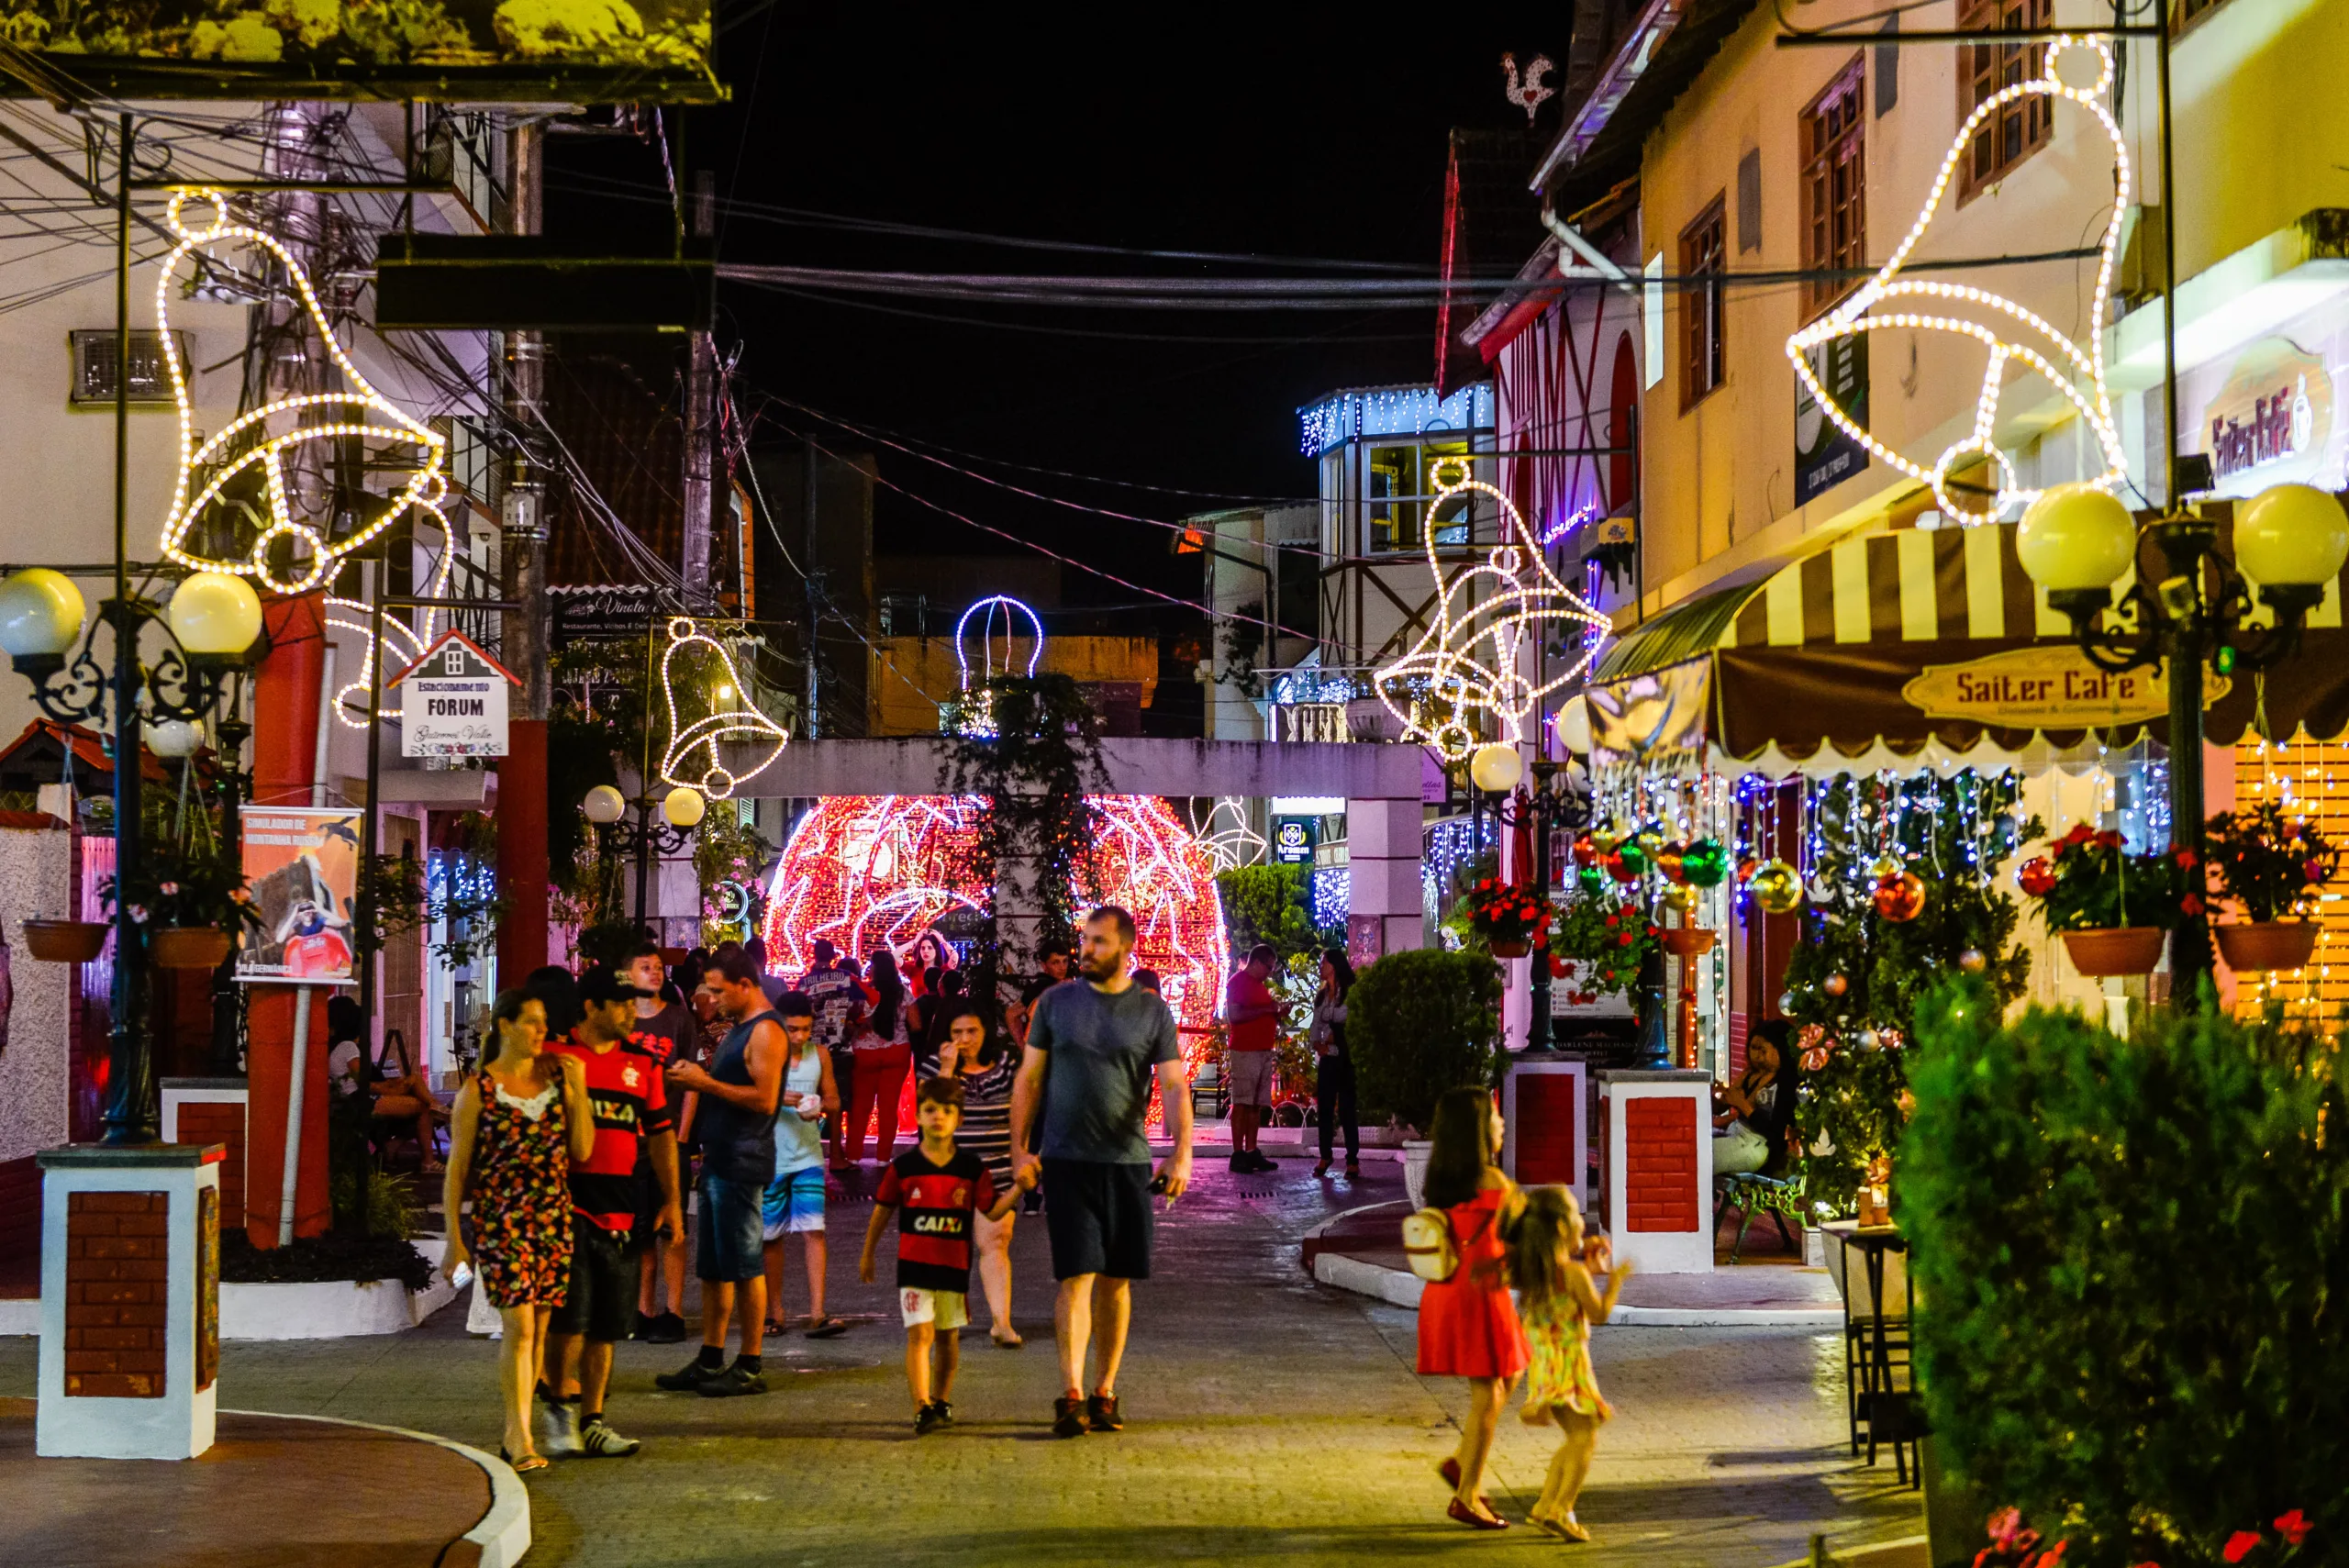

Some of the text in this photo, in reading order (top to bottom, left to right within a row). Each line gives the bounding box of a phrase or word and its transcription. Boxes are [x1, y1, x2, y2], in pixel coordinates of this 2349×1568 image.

[417, 682, 490, 693] Estacionamento
[1956, 673, 2054, 703] Saiter
[246, 817, 306, 830] SIMULADOR DE
[246, 833, 292, 846] MONTANHA
[804, 972, 845, 985] TRILHEIRO
